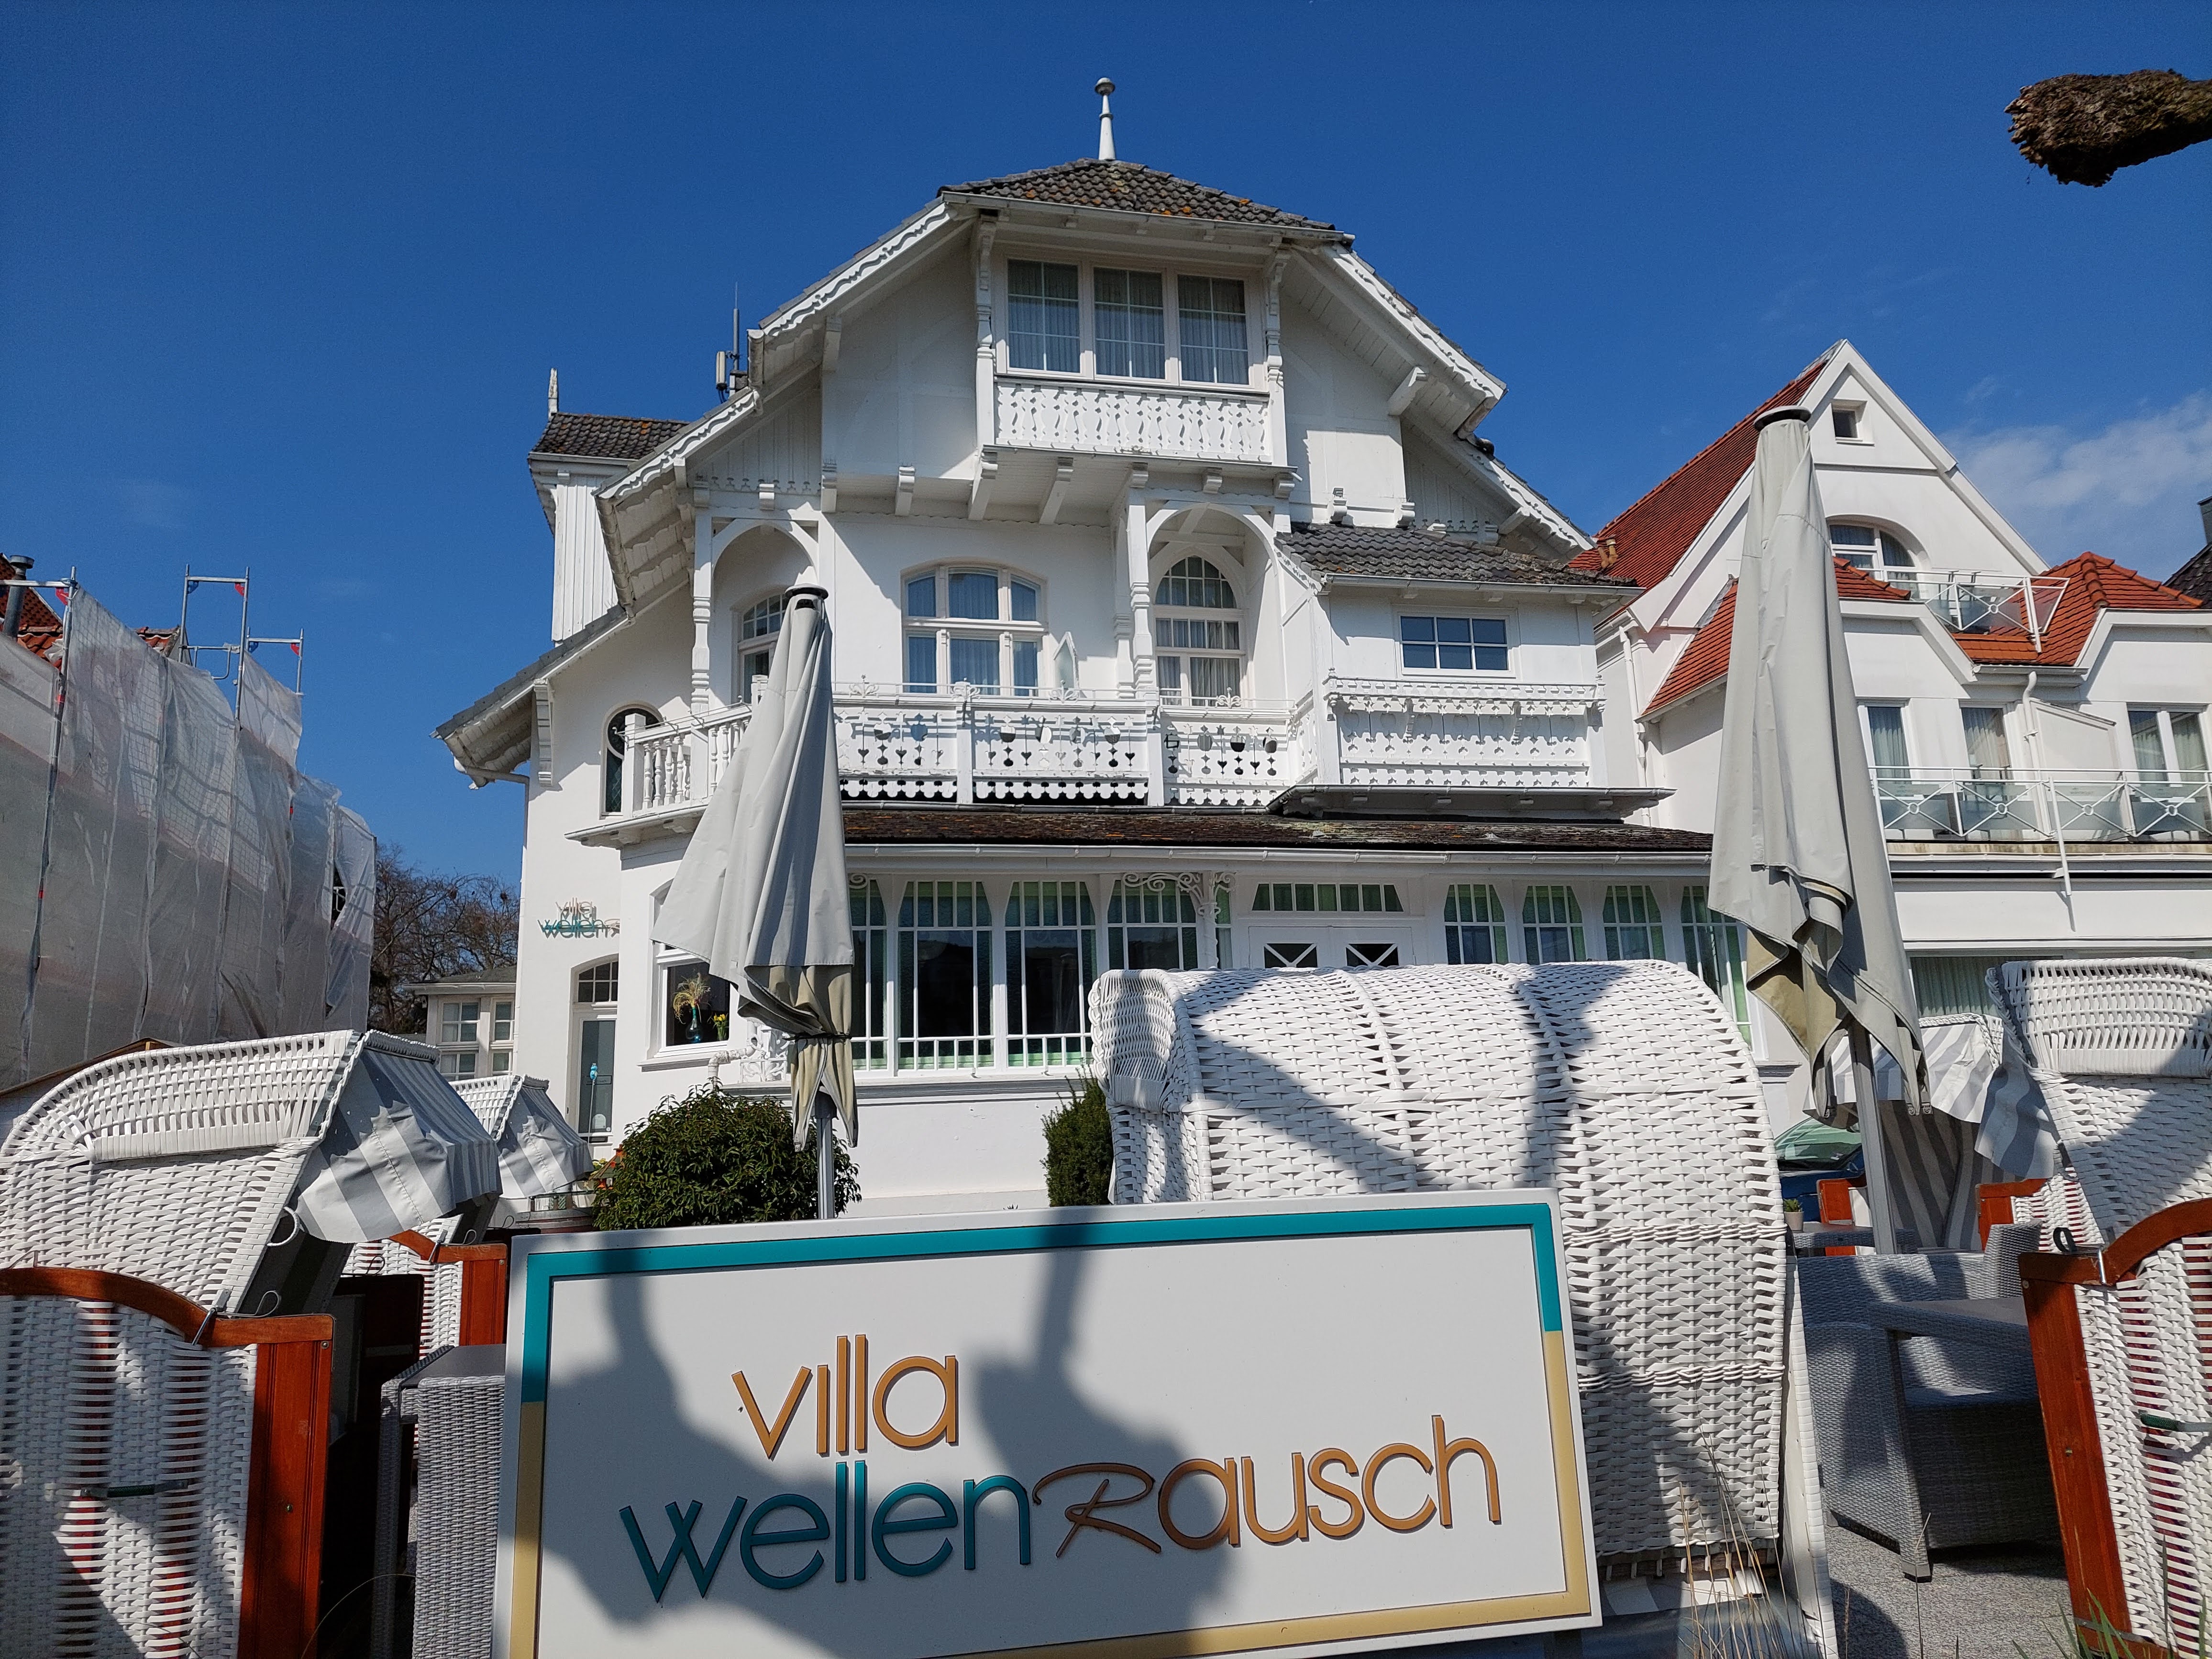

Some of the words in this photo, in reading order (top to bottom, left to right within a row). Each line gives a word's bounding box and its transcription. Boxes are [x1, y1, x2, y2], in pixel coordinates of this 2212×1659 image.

[555, 897, 594, 916] villa
[731, 1334, 958, 1460] villa
[619, 1414, 1502, 1604] wellenRausch
